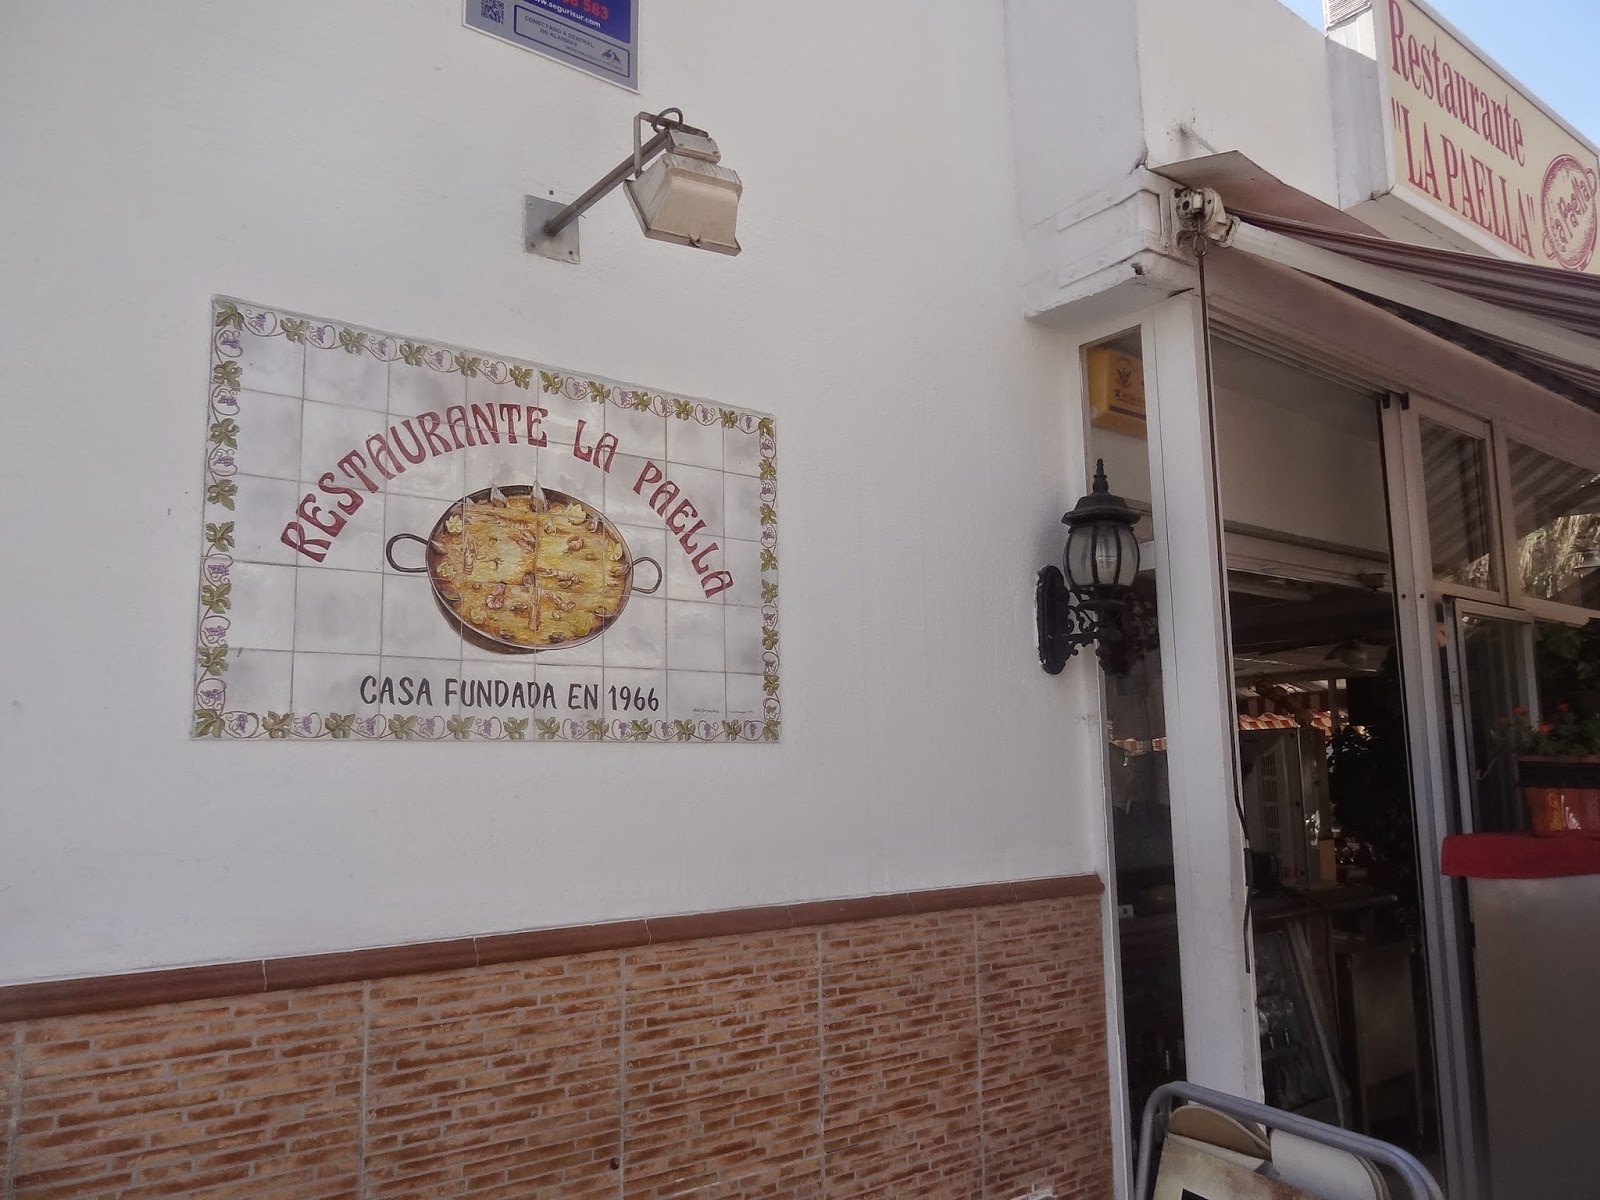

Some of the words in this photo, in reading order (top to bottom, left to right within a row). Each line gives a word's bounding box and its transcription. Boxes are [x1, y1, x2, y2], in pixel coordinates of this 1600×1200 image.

[525, 15, 562, 35] CONECTADO
[569, 32, 594, 48] CENTRAL
[540, 28, 549, 36] DE
[550, 30, 578, 47] ALARMAS
[1388, 0, 1525, 167] Restaurante
[280, 402, 549, 563] RESTAURANTE
[573, 419, 619, 474] LA
[632, 460, 734, 599] PAELLA
[360, 675, 433, 707] CASA
[445, 678, 558, 710] FUNDADA
[568, 683, 599, 711] EN
[607, 684, 660, 713] 1966
